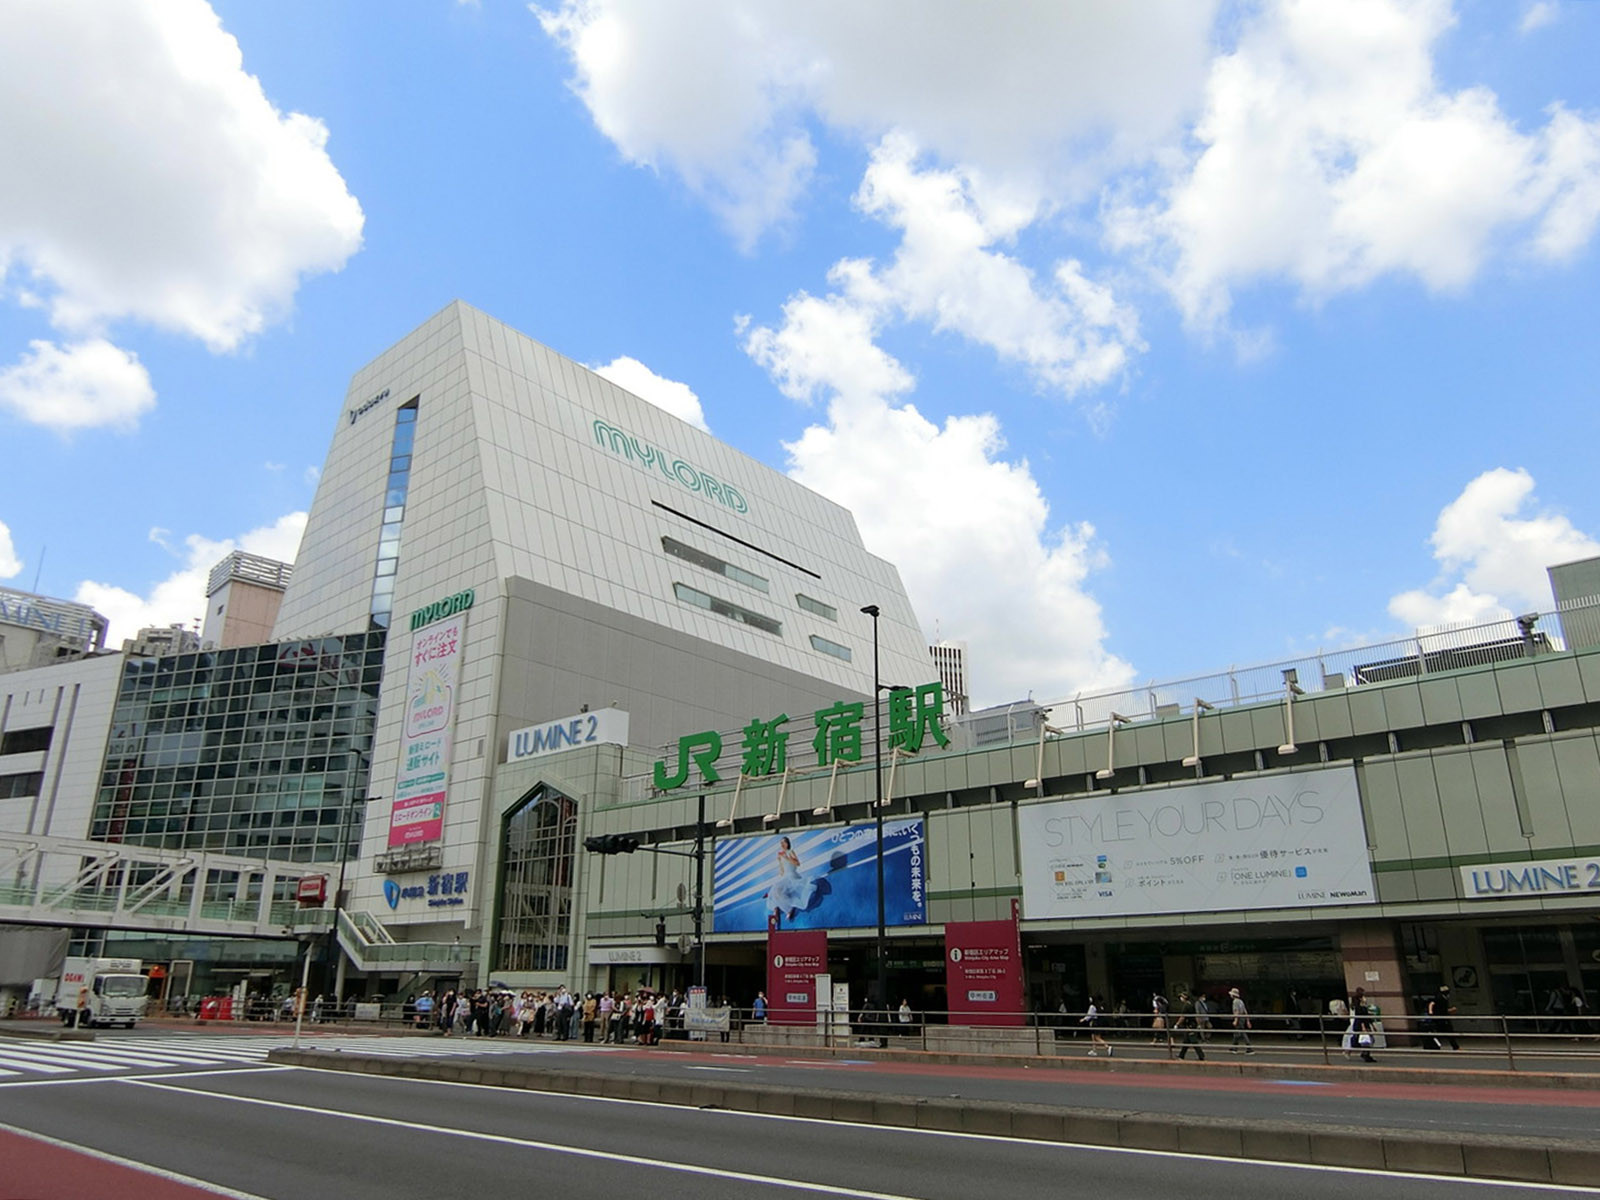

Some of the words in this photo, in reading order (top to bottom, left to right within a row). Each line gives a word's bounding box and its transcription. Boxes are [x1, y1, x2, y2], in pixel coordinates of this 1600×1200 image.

[593, 419, 748, 514] MYLORD
[411, 588, 475, 632] MYLORD
[515, 719, 584, 757] LUMINE
[585, 715, 598, 742] 2
[1045, 809, 1135, 848] STYLE
[1137, 800, 1226, 838] YOUR
[1232, 790, 1324, 831] DAYS
[1169, 854, 1204, 865] 5%OFF
[1471, 864, 1580, 894] LUMINE
[1586, 862, 1600, 887] 2
[608, 950, 636, 962] LUMINE
